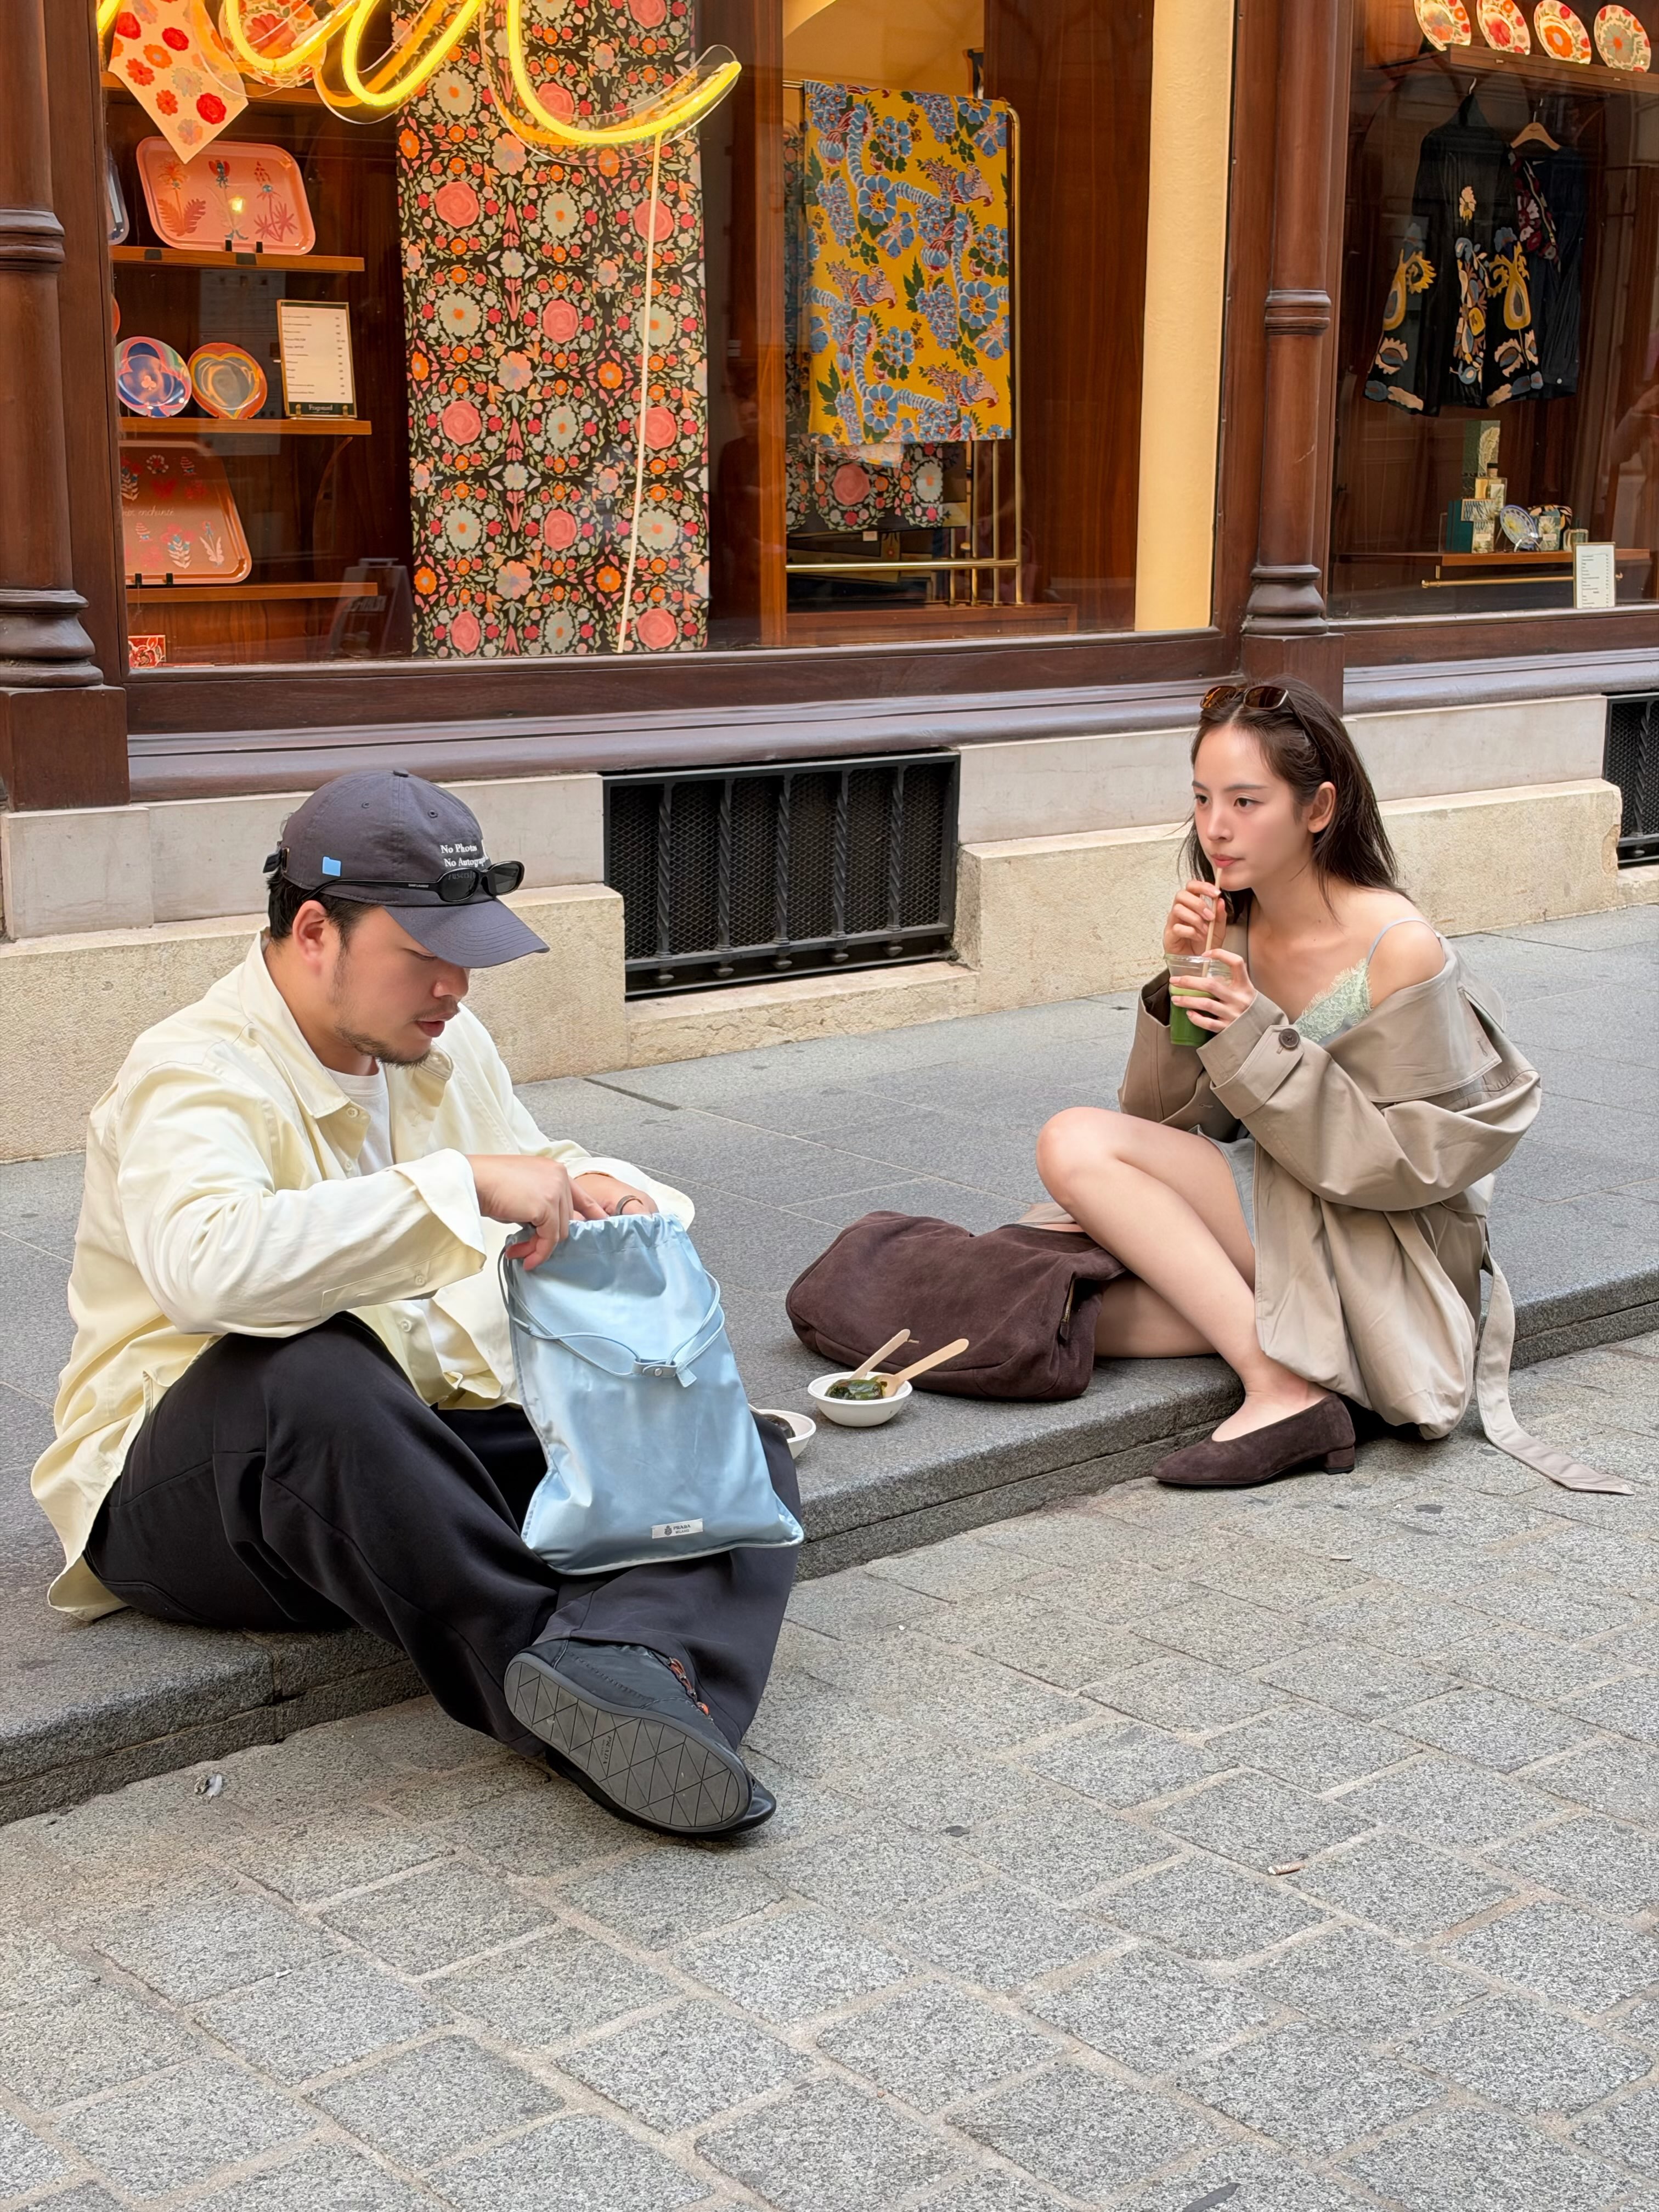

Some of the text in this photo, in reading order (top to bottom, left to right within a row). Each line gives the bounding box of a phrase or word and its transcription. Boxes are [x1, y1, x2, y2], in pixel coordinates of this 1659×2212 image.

[440, 843, 477, 854] No Photos
[443, 858, 456, 867] No
